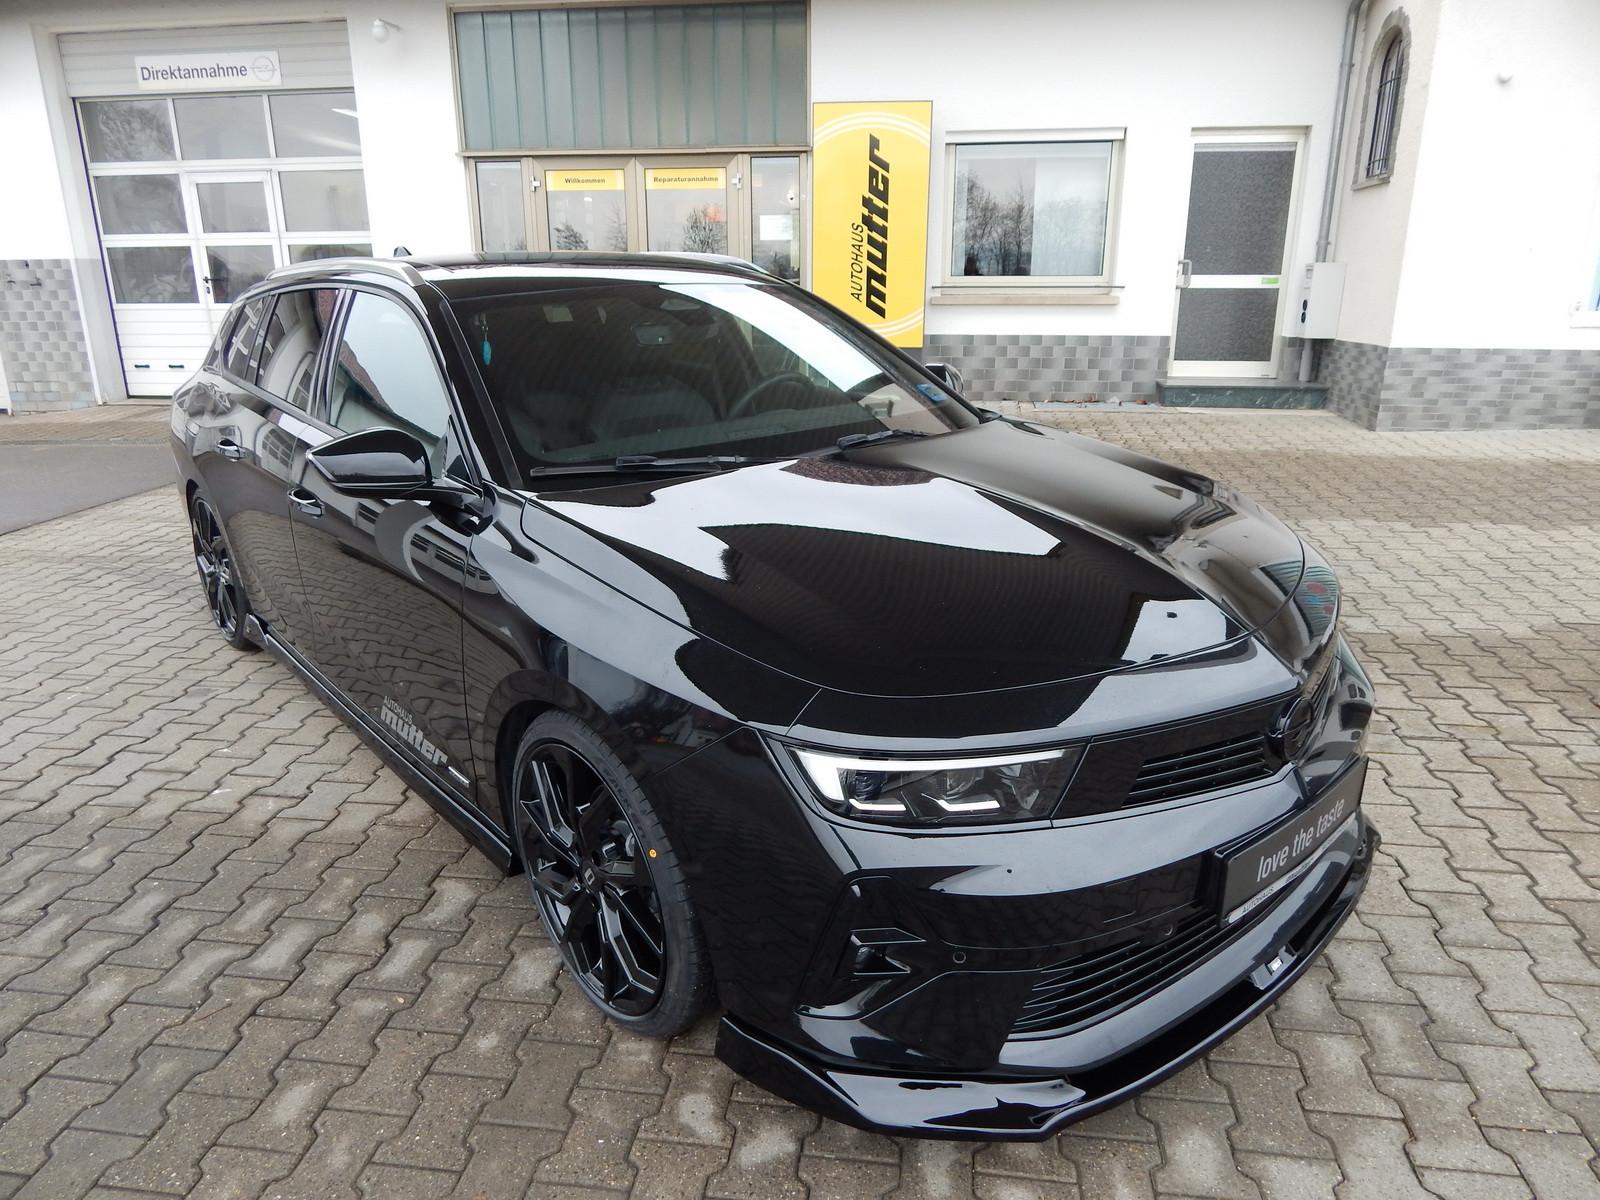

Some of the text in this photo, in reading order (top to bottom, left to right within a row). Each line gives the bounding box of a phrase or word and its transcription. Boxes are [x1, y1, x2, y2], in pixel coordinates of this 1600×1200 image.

[140, 63, 248, 81] Direktannahme
[653, 175, 719, 184] Reparaturannahme
[861, 133, 890, 319] mutter
[850, 222, 864, 303] AUTOHAUS
[380, 704, 449, 766] mutter
[383, 695, 414, 725] AUTOHAUS
[1256, 845, 1290, 883] love
[1292, 827, 1314, 857] the
[1316, 798, 1345, 838] taste
